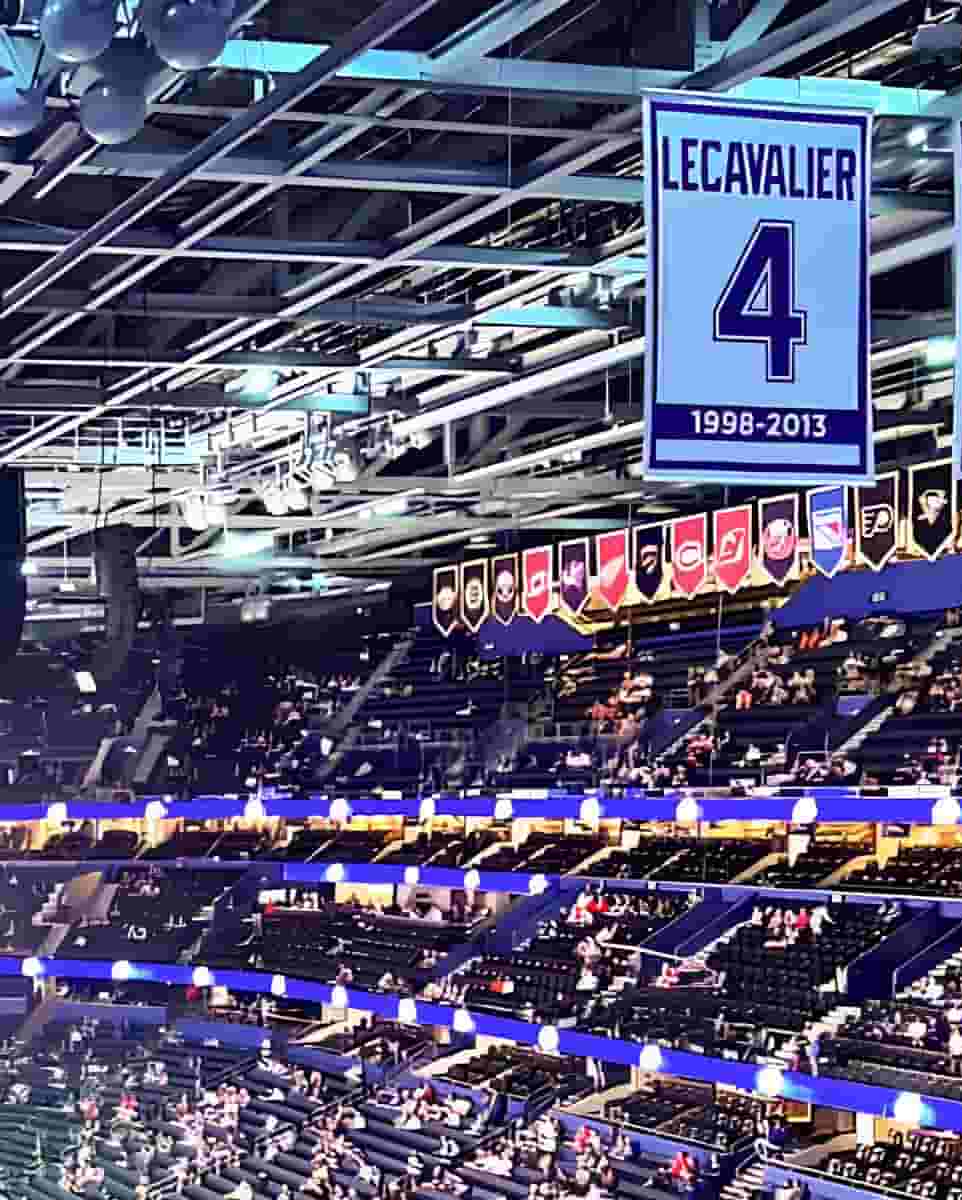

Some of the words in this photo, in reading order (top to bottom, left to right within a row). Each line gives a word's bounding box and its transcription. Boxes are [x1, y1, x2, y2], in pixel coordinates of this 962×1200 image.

[661, 135, 858, 201] LECAVALIER
[713, 219, 808, 384] 4
[690, 409, 827, 438] 1998-2013
